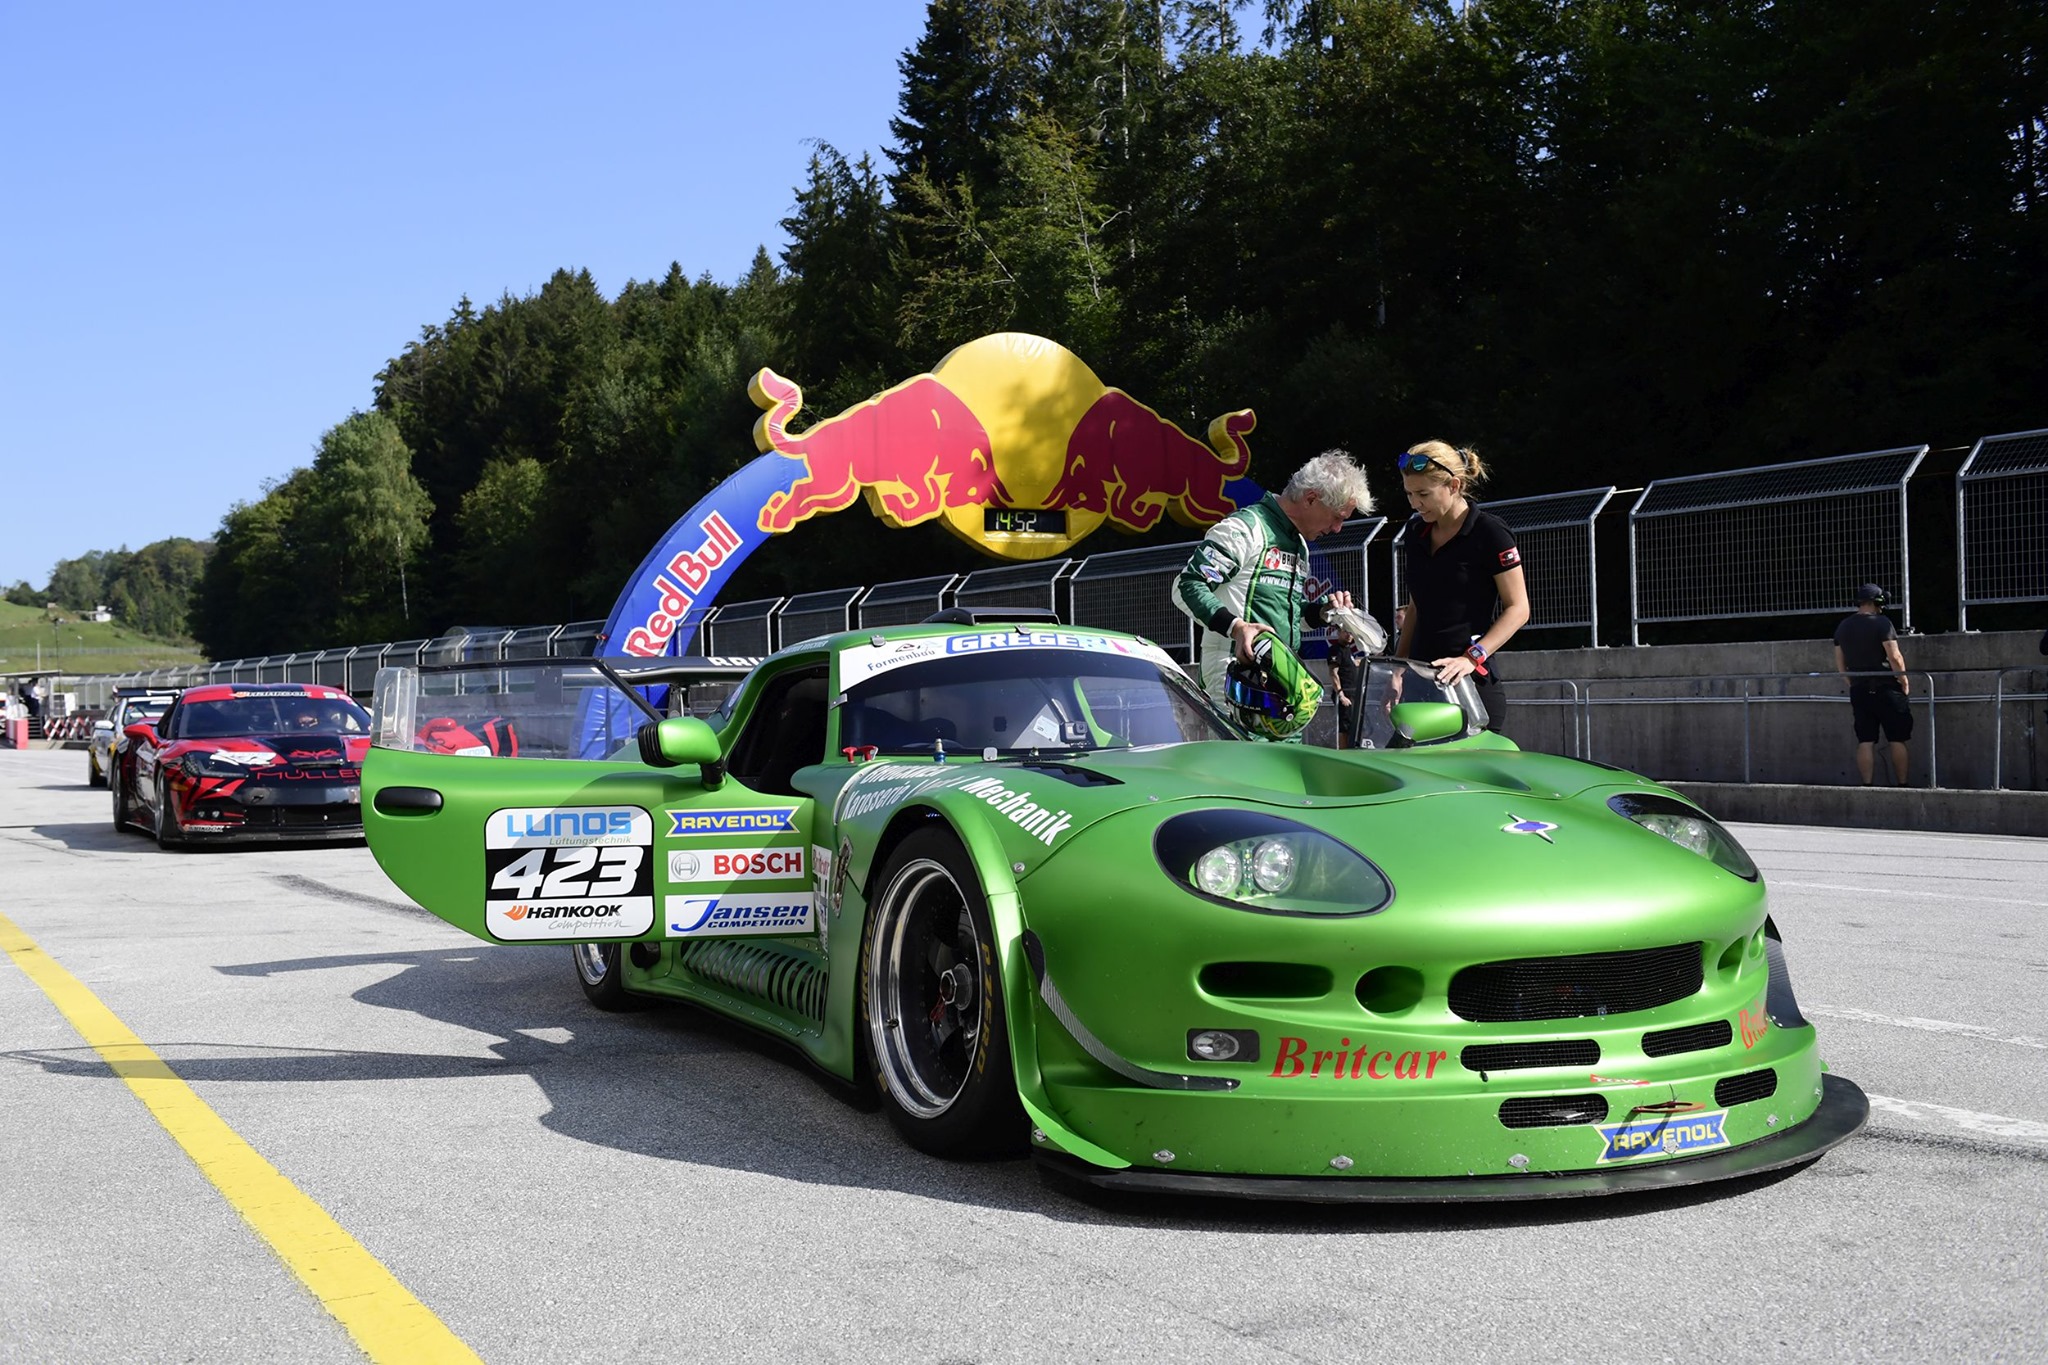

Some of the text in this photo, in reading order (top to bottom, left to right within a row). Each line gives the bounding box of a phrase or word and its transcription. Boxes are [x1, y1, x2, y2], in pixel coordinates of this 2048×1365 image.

[995, 512, 1037, 532] 14:52
[625, 513, 741, 657] Red Bull
[867, 650, 936, 671] Formenbau
[681, 814, 785, 829] RAVENOL
[841, 781, 911, 821] Karosserie
[958, 777, 1073, 846] Mechanik
[507, 812, 632, 837] LUNOS
[549, 836, 632, 846] Lüftungstechnik
[491, 846, 644, 899] 423
[714, 852, 802, 875] BOSCH
[671, 899, 809, 932] Jansen
[707, 918, 807, 929] COMPETITION
[1268, 1036, 1447, 1080] Britcar
[1613, 1122, 1720, 1151] RAVENOL
